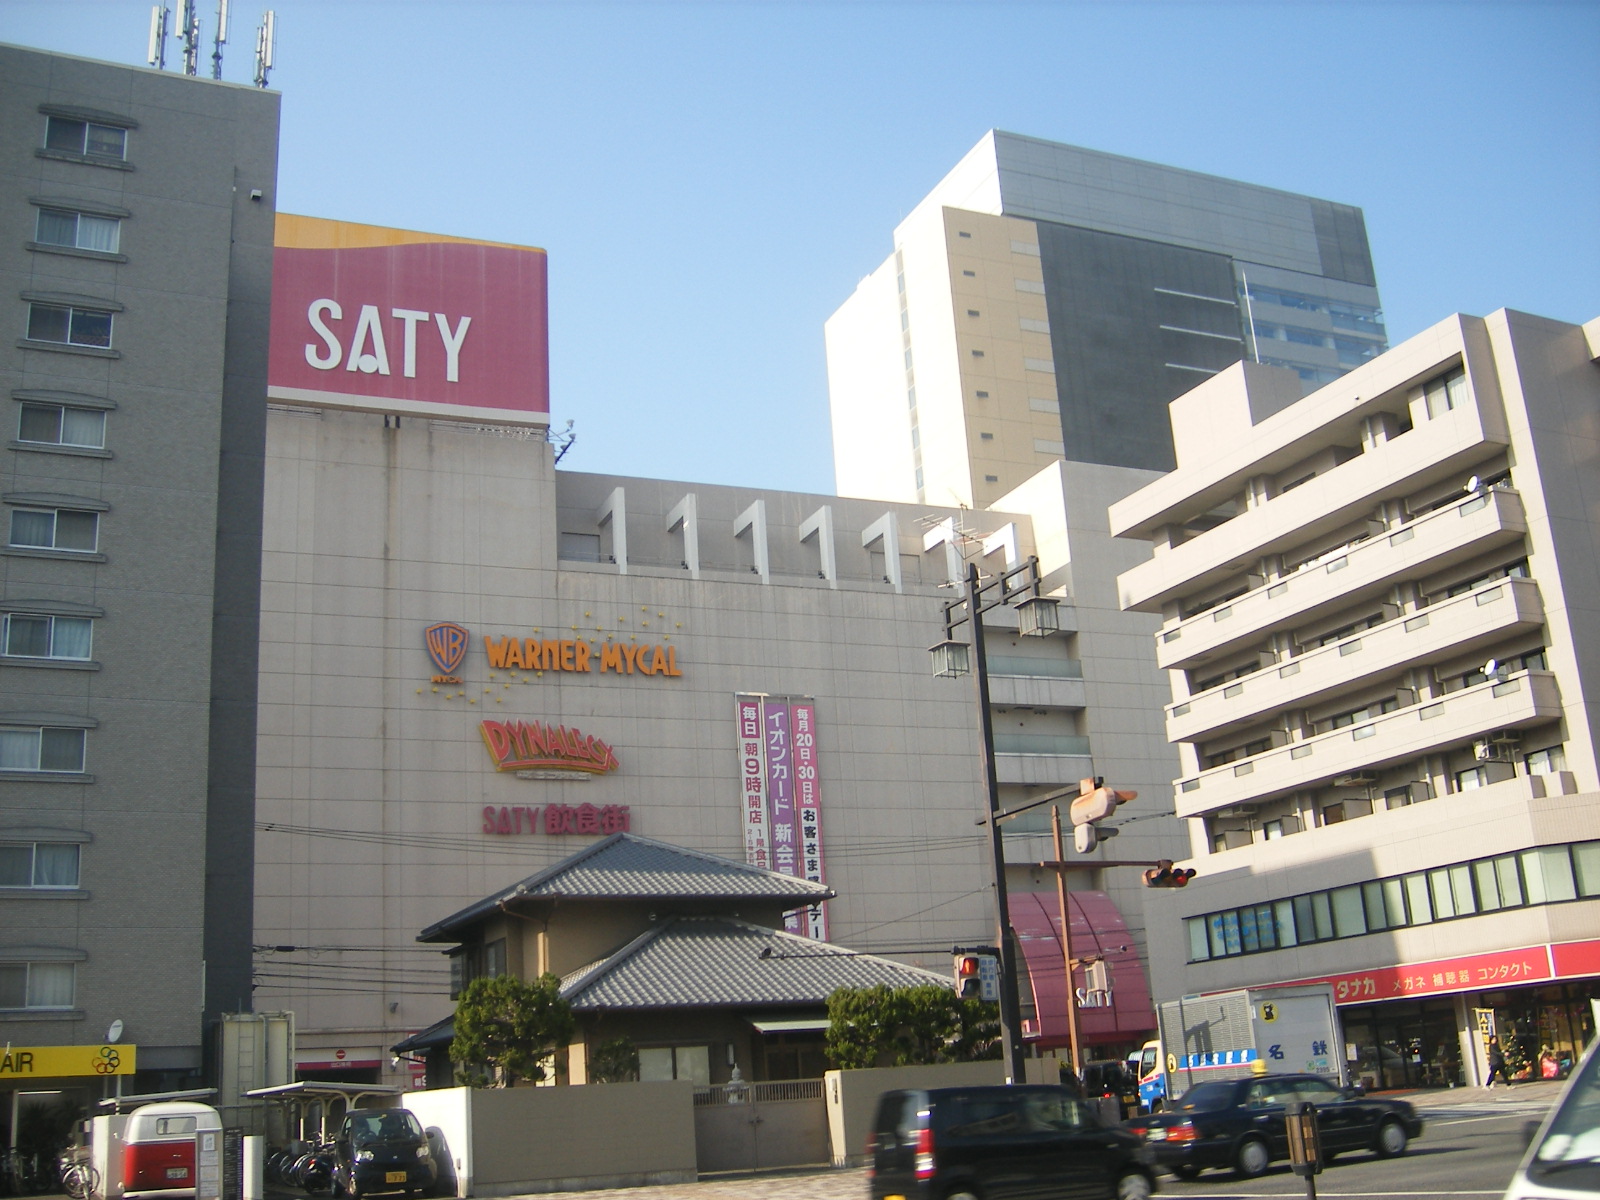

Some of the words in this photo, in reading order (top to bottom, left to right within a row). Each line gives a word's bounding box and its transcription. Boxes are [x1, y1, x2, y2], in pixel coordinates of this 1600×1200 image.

[305, 298, 472, 382] SATY
[431, 628, 463, 665] WB
[484, 635, 590, 672] WARNER
[601, 642, 682, 677] MYCAL
[742, 706, 756, 735] 毎日
[769, 711, 789, 816] イオンカード
[745, 742, 762, 824] 朝9時開店
[482, 805, 540, 835] SATY
[544, 802, 630, 834] 飲食街
[1075, 987, 1113, 1008] SATY
[1337, 977, 1376, 999] タナカ
[1393, 976, 1426, 992] メガネ
[1433, 970, 1470, 987] 補聴器
[1477, 961, 1533, 981] コンタクト
